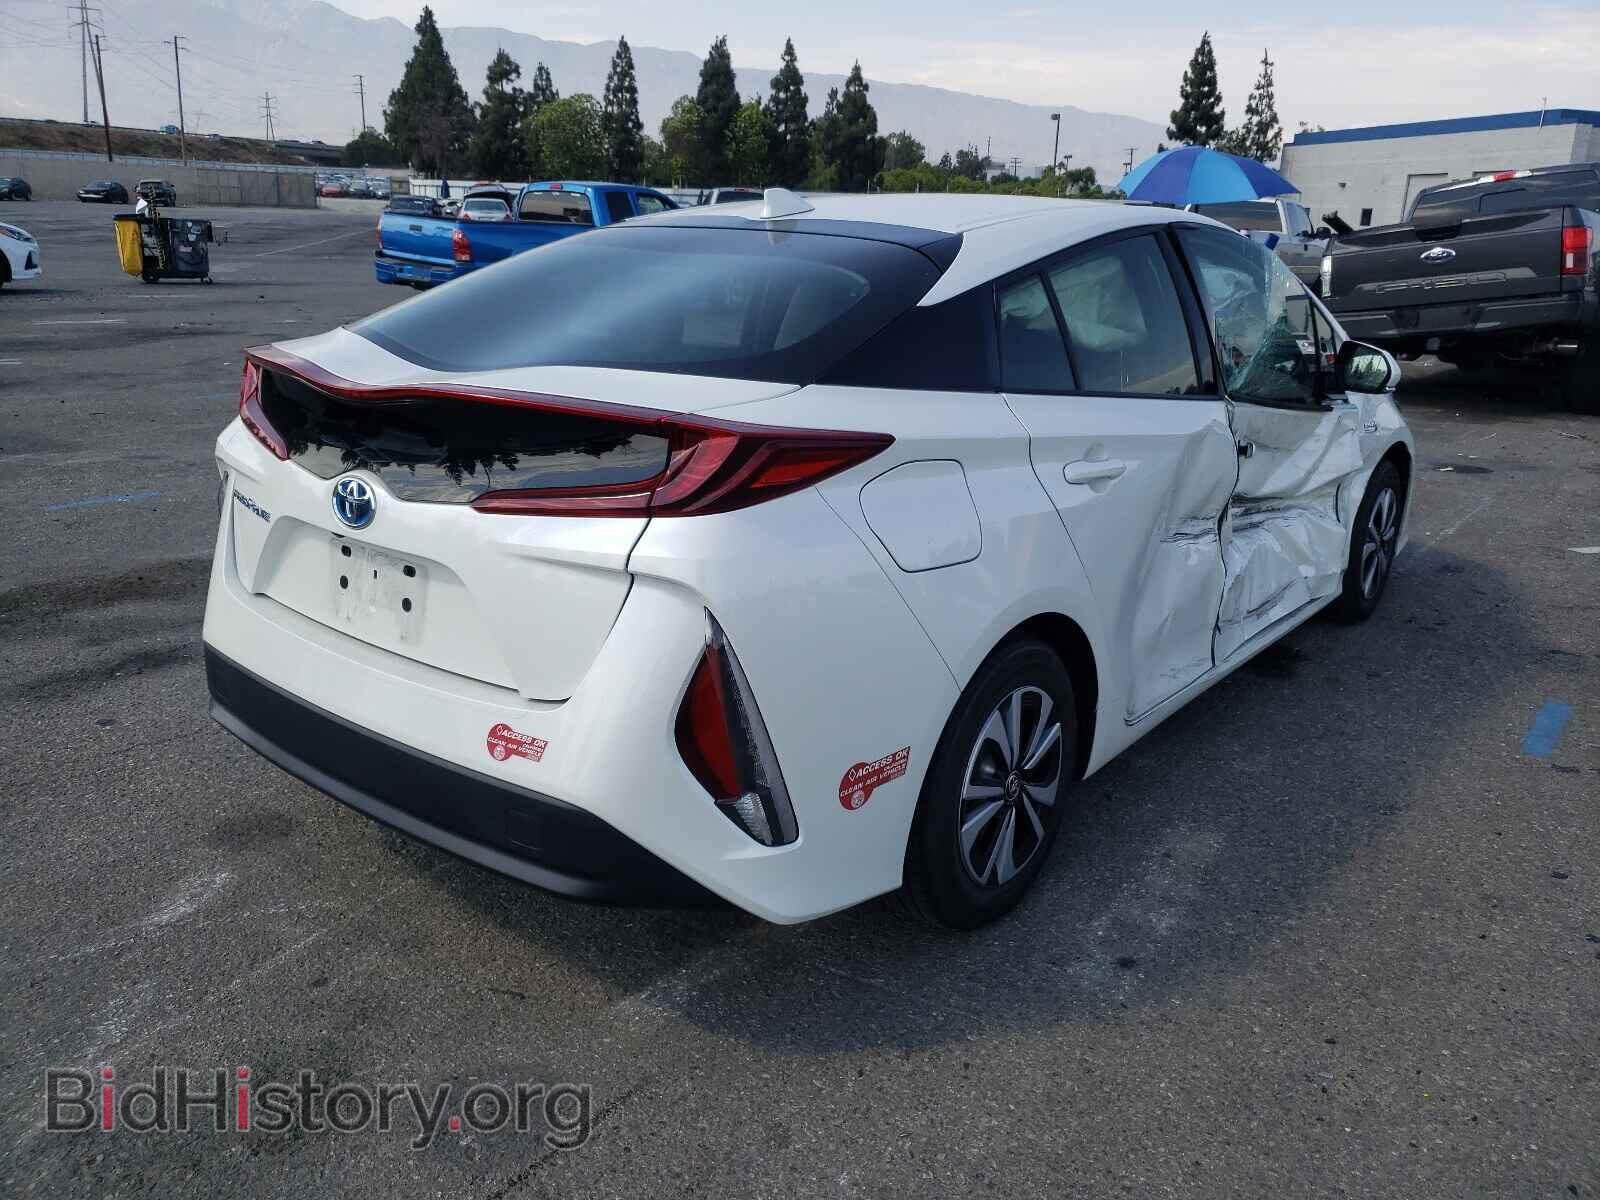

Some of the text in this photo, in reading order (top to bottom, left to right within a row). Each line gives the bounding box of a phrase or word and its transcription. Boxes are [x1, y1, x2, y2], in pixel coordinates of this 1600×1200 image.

[501, 729, 533, 744] ACCESS
[533, 739, 546, 748] OK
[856, 755, 893, 778] ACCESS
[895, 749, 908, 761] OK
